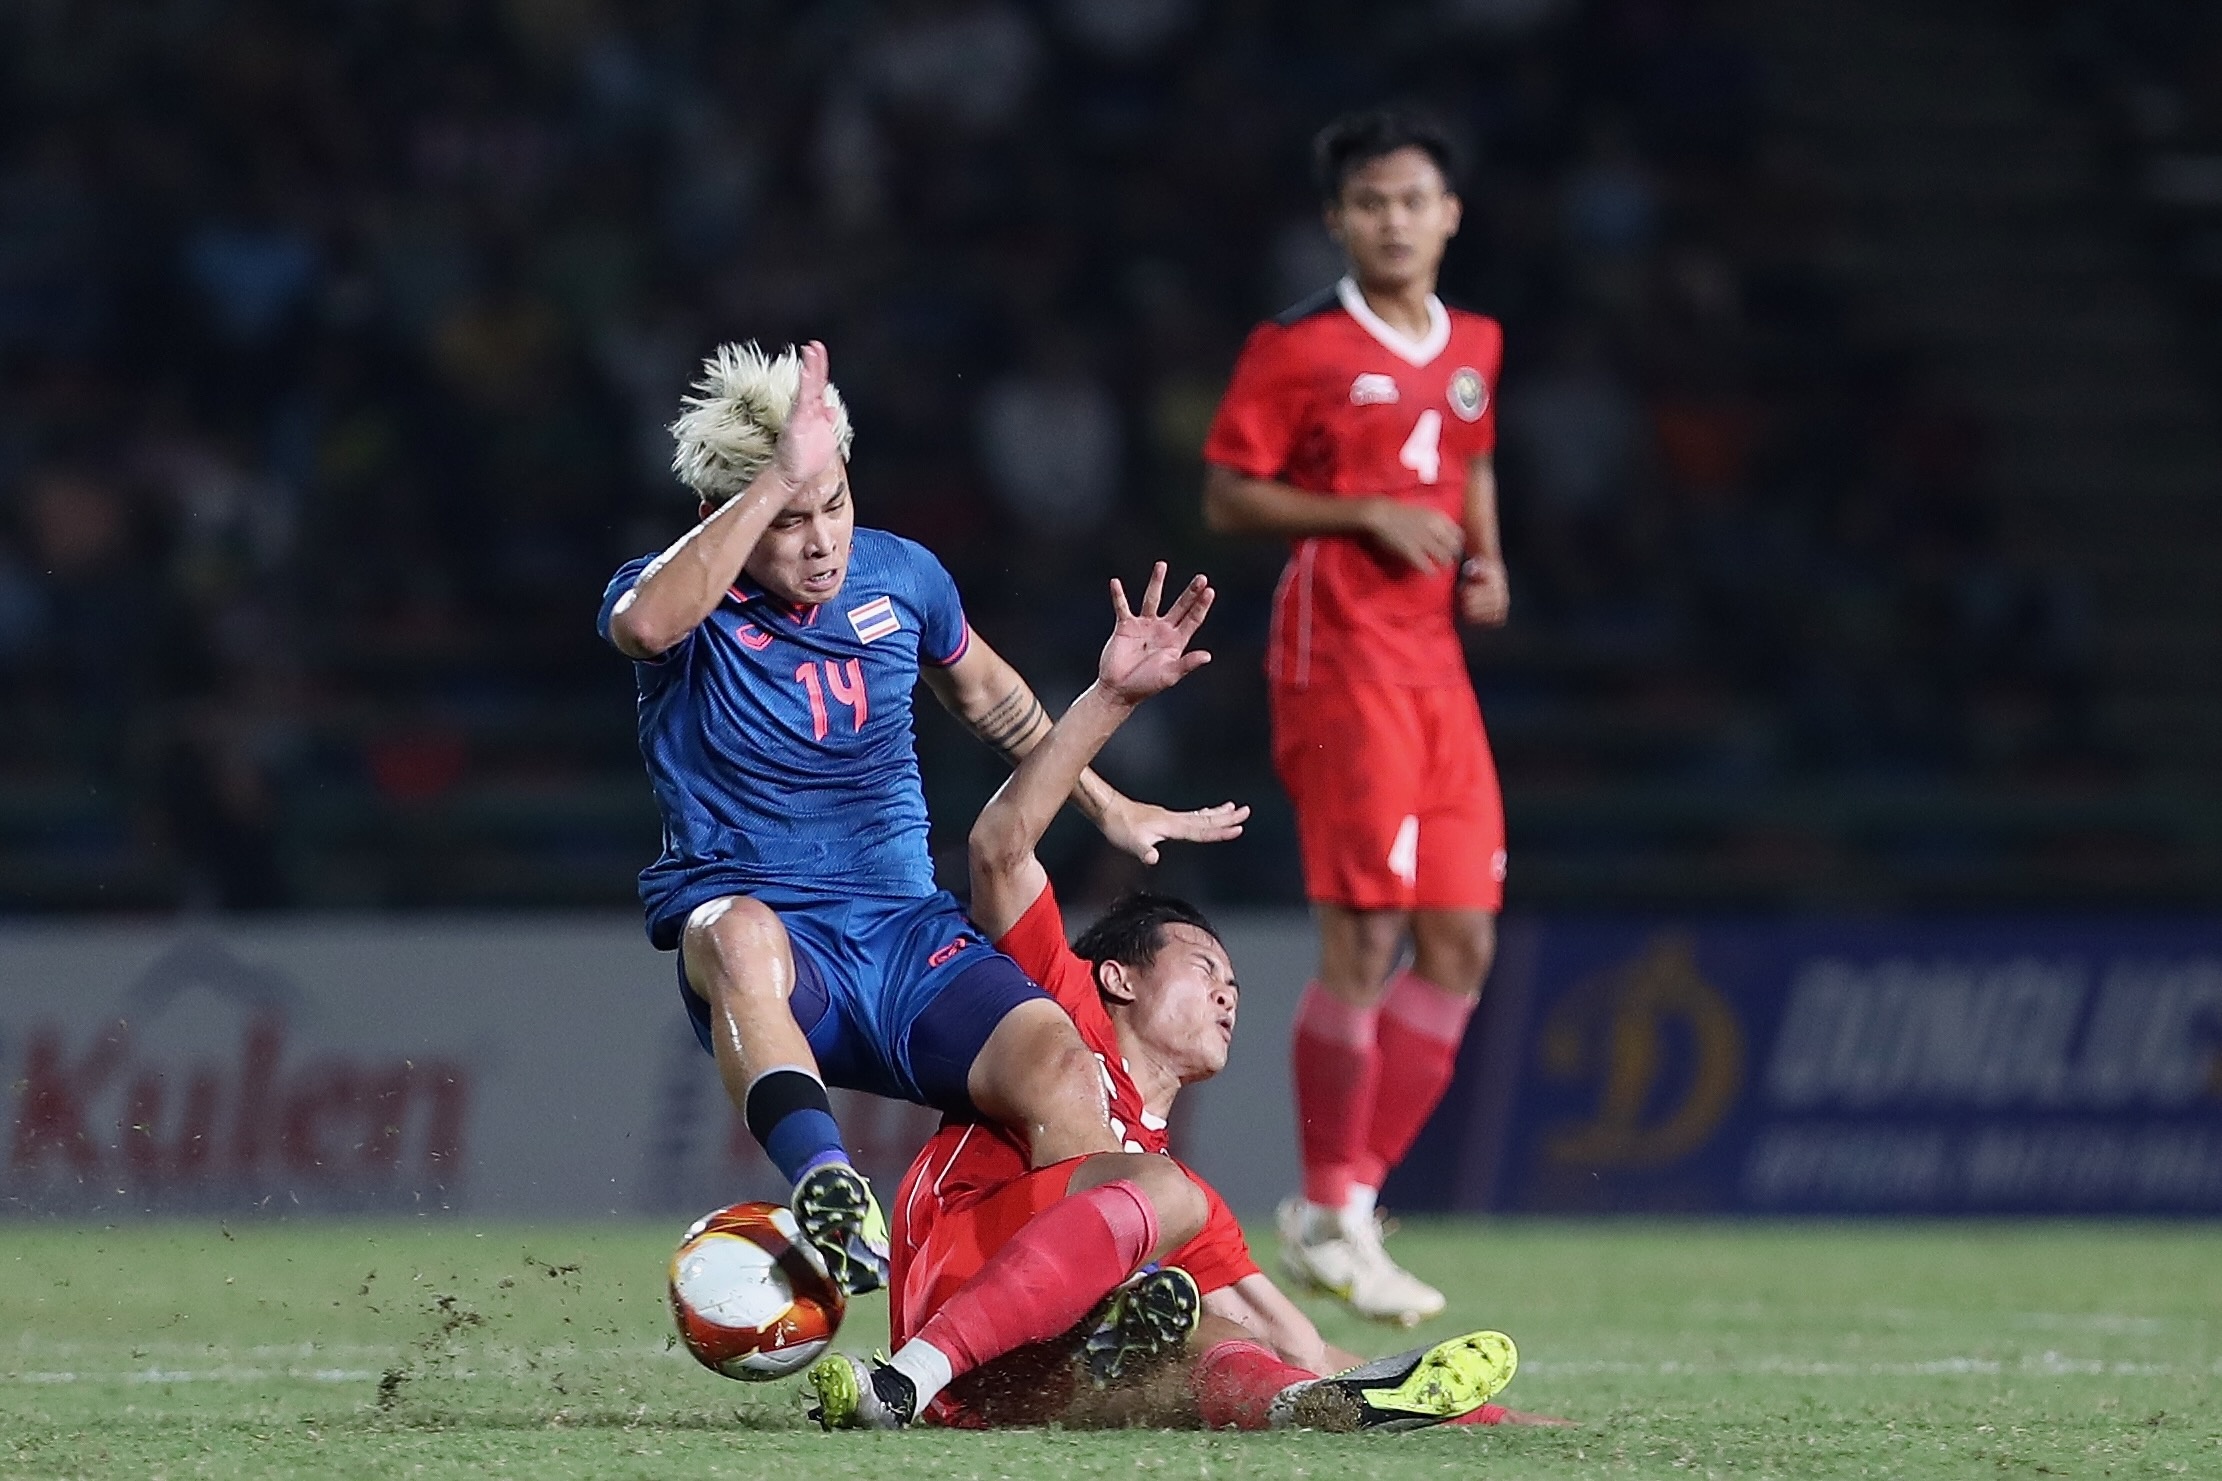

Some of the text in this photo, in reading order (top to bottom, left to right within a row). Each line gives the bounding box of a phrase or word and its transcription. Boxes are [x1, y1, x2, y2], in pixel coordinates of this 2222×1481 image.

[1400, 408, 1442, 485] 4
[795, 658, 868, 741] 14
[1387, 813, 1420, 888] 4
